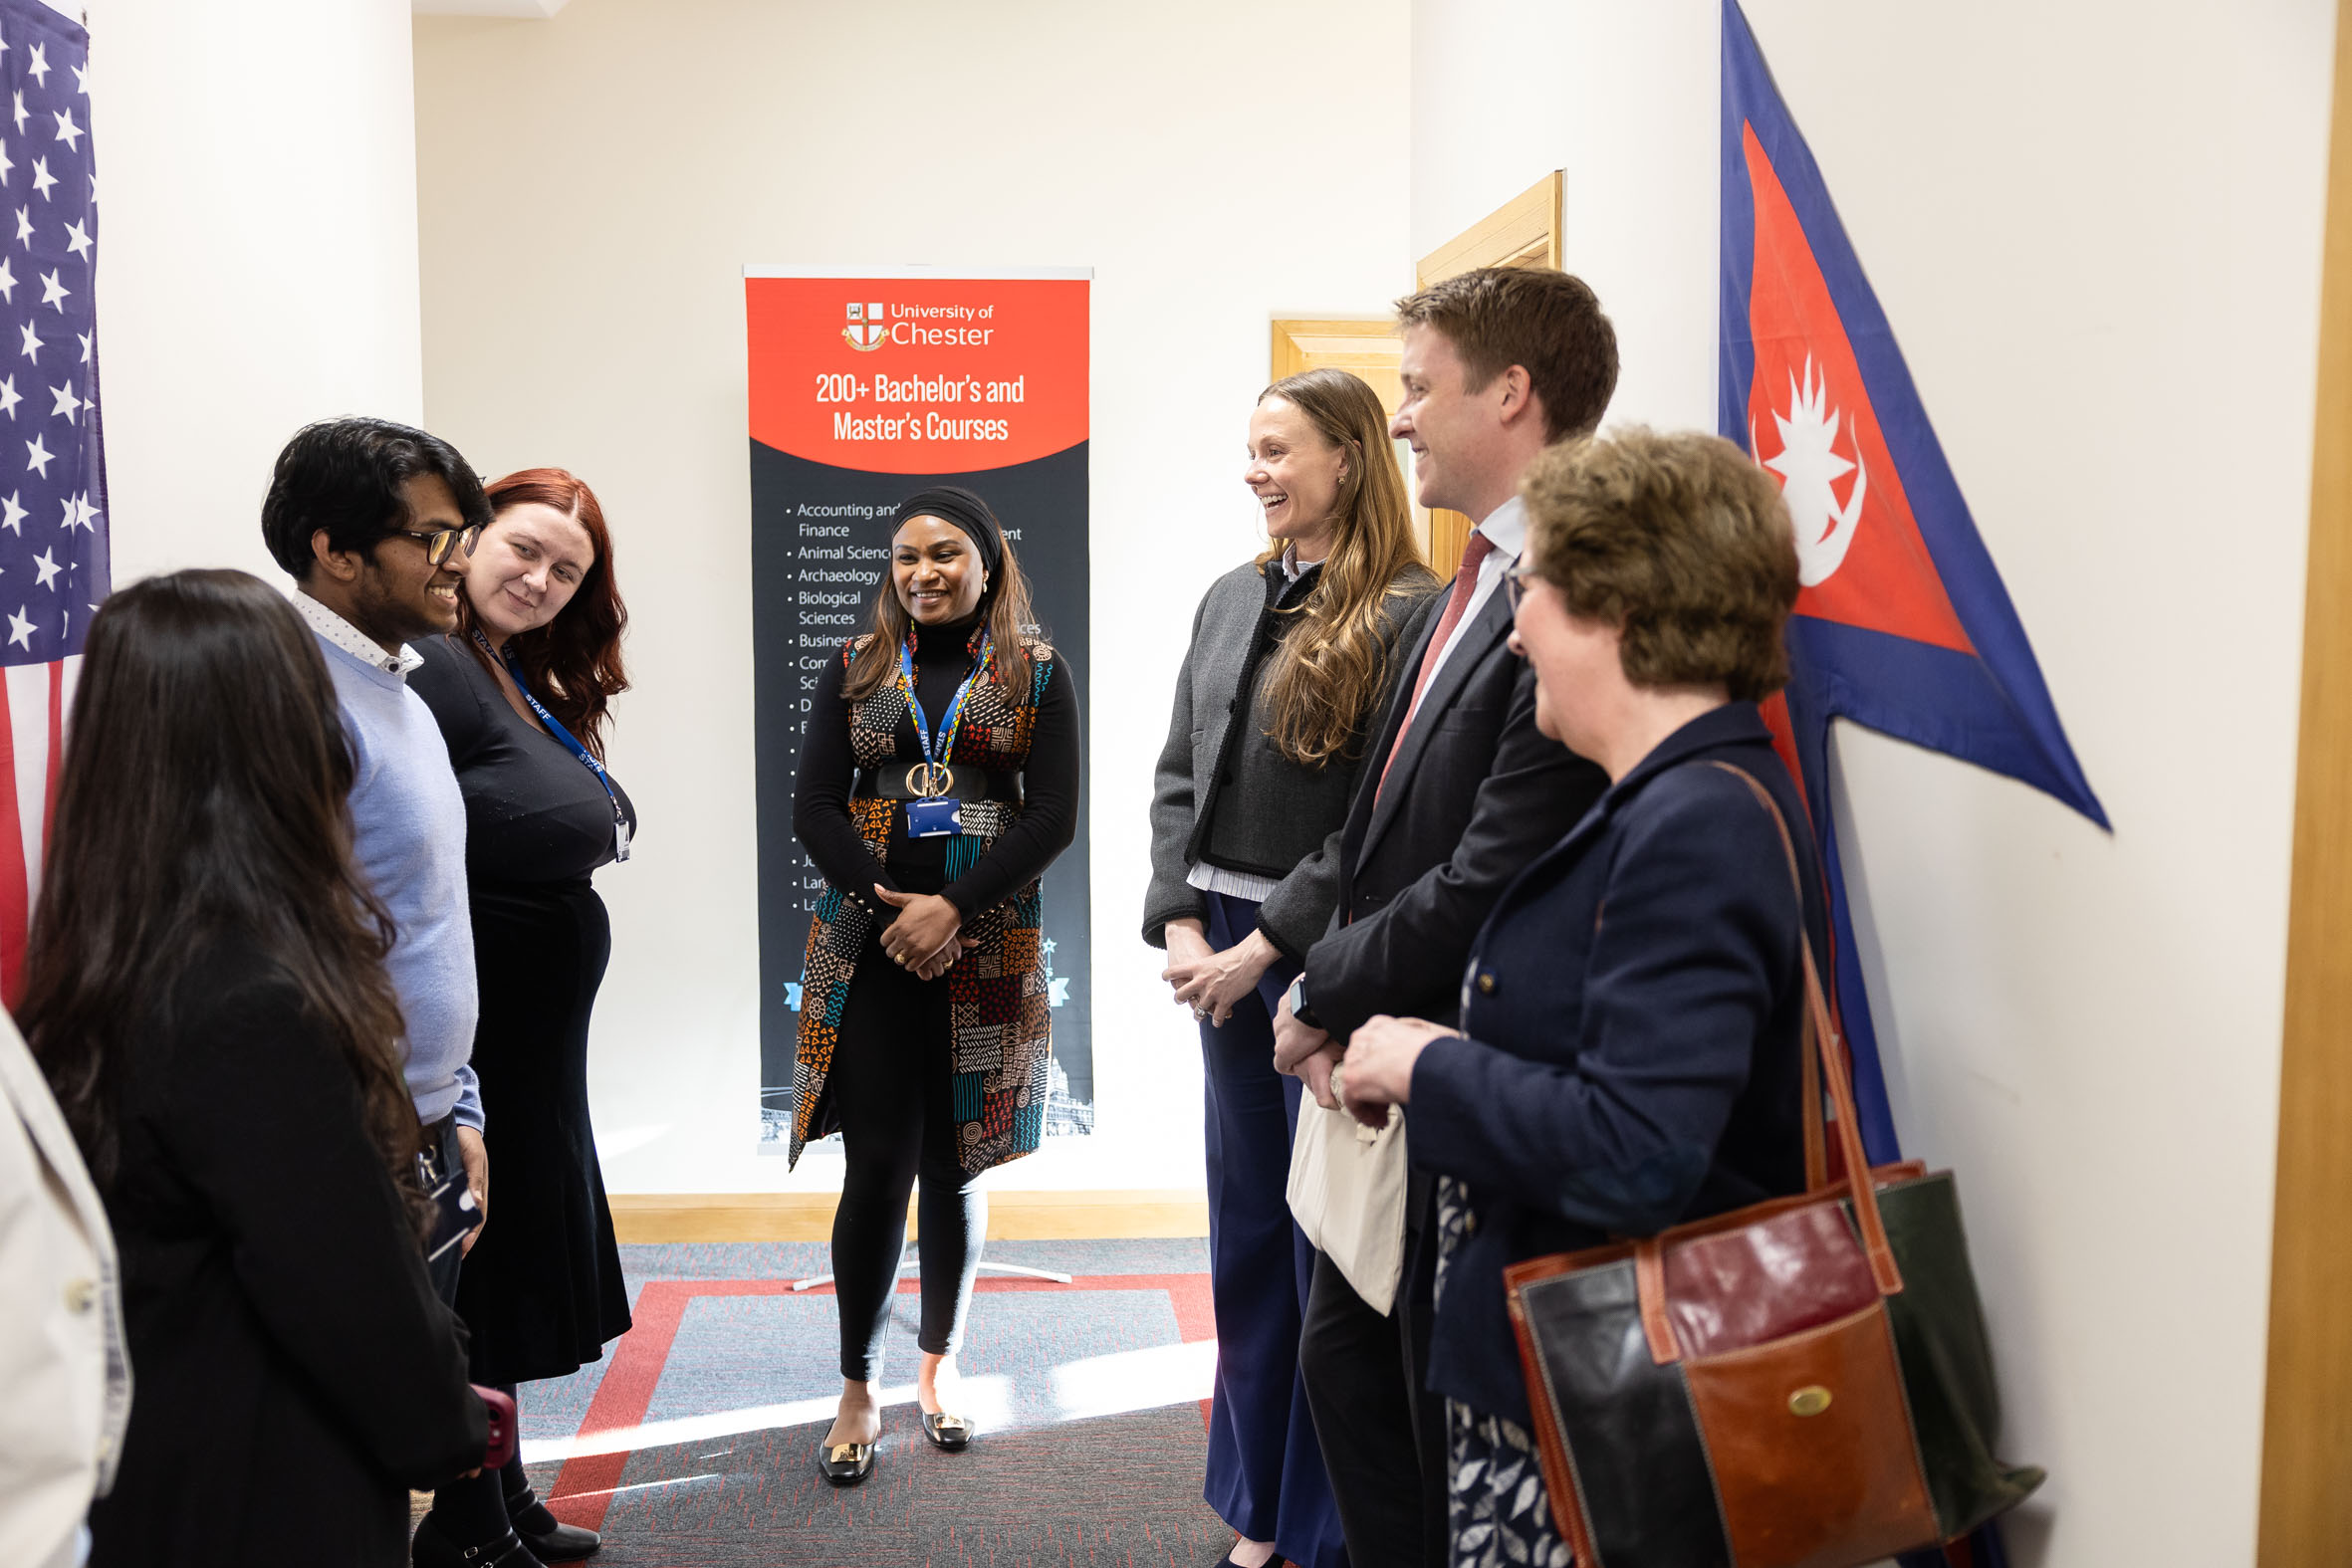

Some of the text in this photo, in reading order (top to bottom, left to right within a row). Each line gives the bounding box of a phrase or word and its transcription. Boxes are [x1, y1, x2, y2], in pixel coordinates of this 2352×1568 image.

[891, 303, 994, 322] University of
[891, 322, 994, 345] Chester
[816, 373, 1025, 403] 200+ Bachelor's and
[833, 411, 1009, 441] Master's Courses
[797, 503, 873, 520] Accounting
[799, 523, 850, 538] Finance
[798, 546, 891, 560] Animal Scienc
[798, 567, 881, 585] Archaeology
[799, 590, 860, 608] Biological
[799, 610, 855, 625] Sciences
[526, 694, 552, 720] STAFF
[919, 729, 931, 757] STAFF
